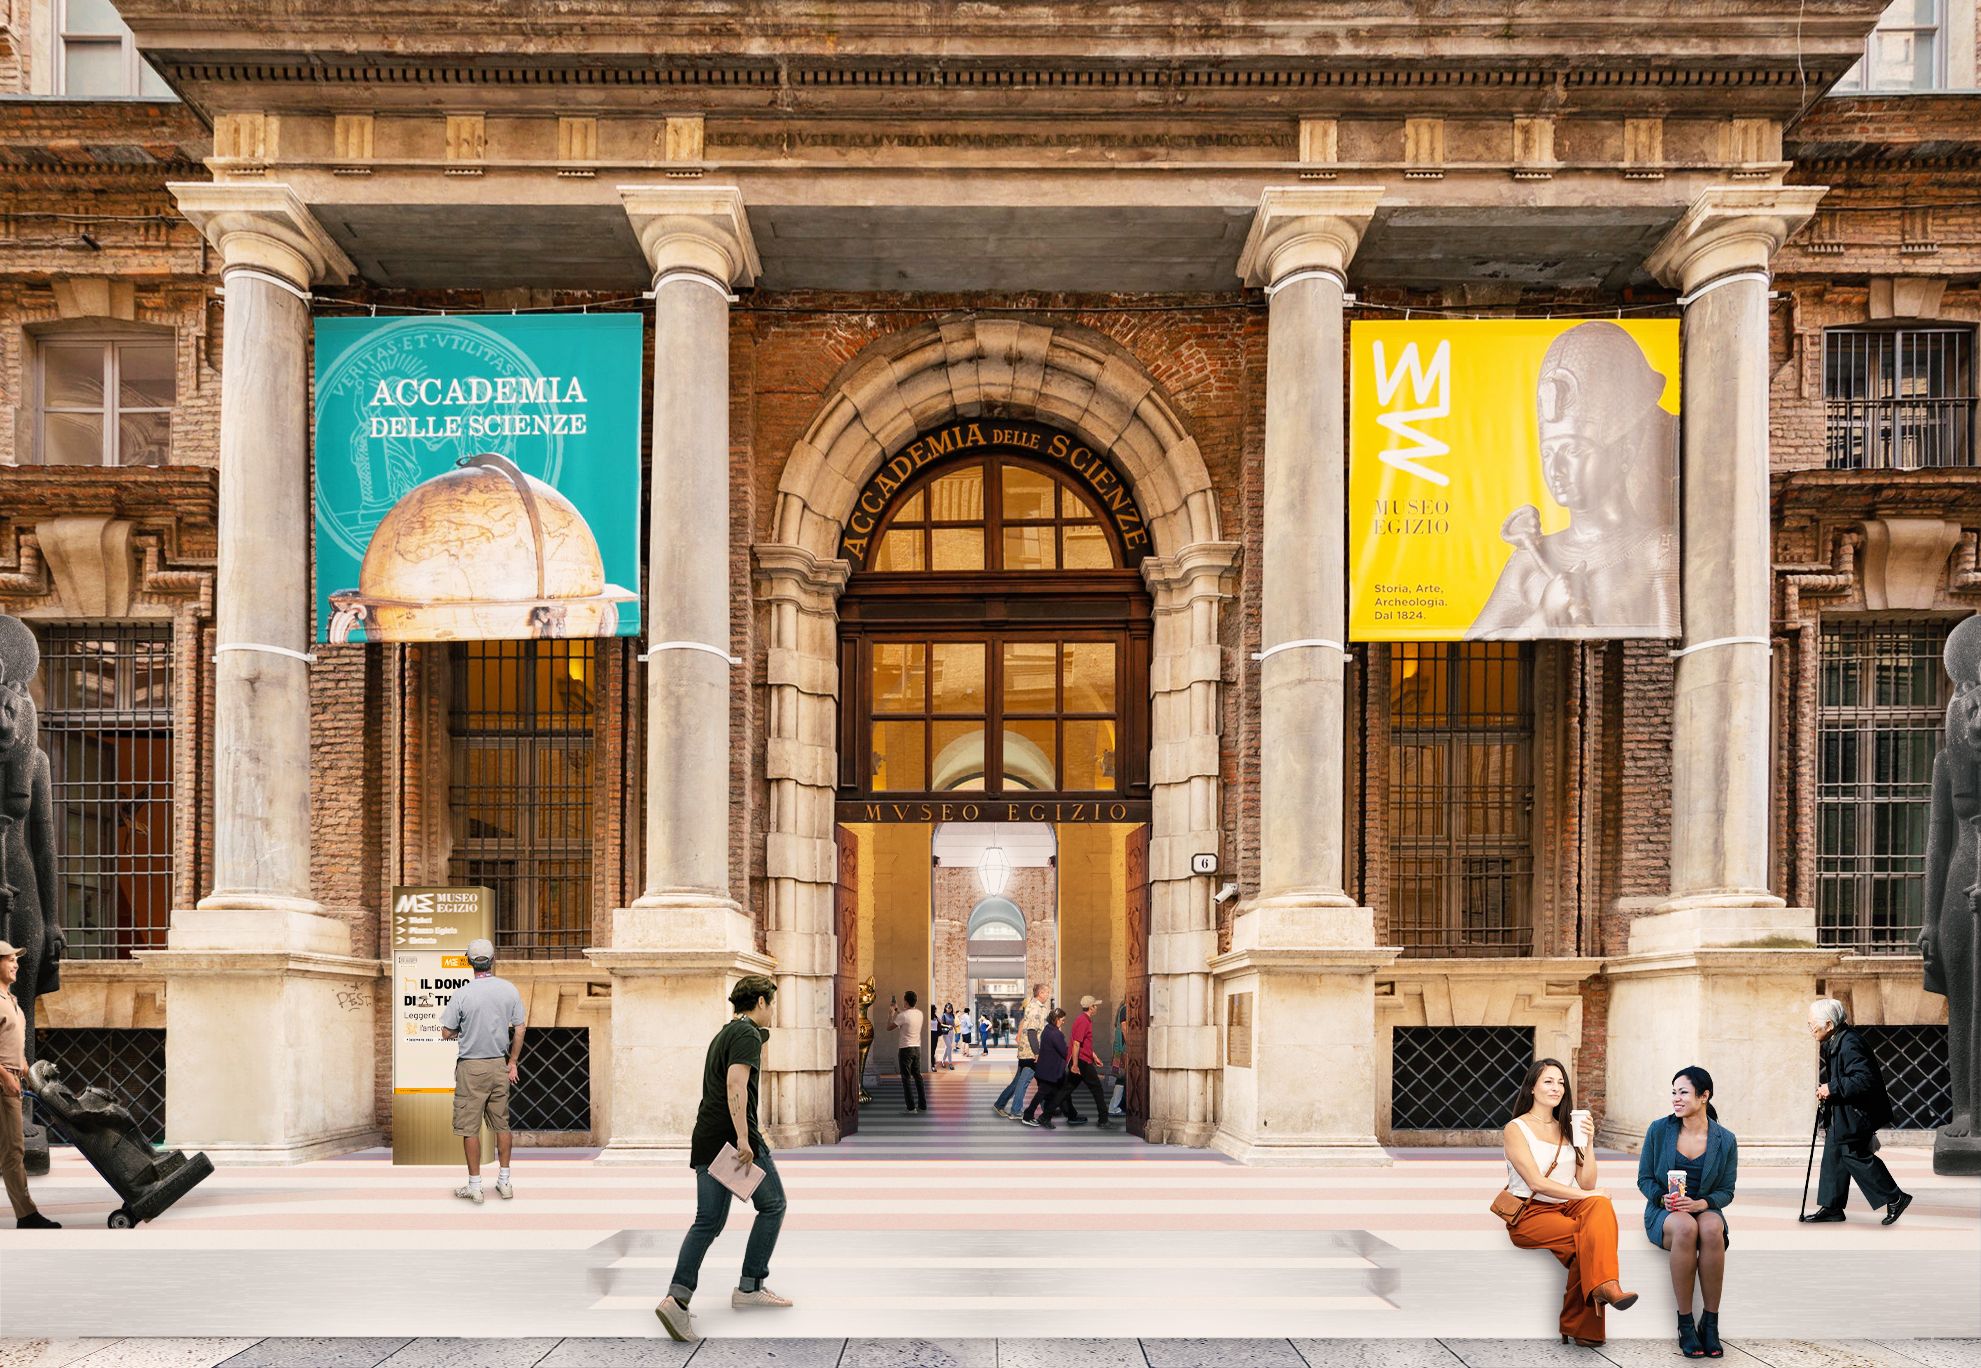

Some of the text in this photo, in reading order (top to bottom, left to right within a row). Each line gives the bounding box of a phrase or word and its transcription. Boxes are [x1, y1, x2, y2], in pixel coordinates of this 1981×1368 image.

[370, 376, 587, 406] ACCADEMIA
[370, 414, 587, 438] DELLE SCIENZE
[843, 423, 1148, 560] ACCADEMIA DELLE SCIENZE
[1374, 500, 1449, 515] MUSEO
[1375, 519, 1449, 535] EGIZIO
[1374, 584, 1444, 594] Storia, Arte,
[1375, 598, 1448, 608] Archeologia.
[1375, 611, 1426, 620] Dal 1824.
[864, 803, 1127, 821] MVSEO EGIZIO
[1201, 858, 1209, 869] 6
[437, 893, 478, 903] MUSEO
[437, 903, 478, 912] EGIZIO
[420, 979, 432, 989] IL
[404, 996, 416, 1006] DI
[404, 1012, 436, 1020] Leggere
